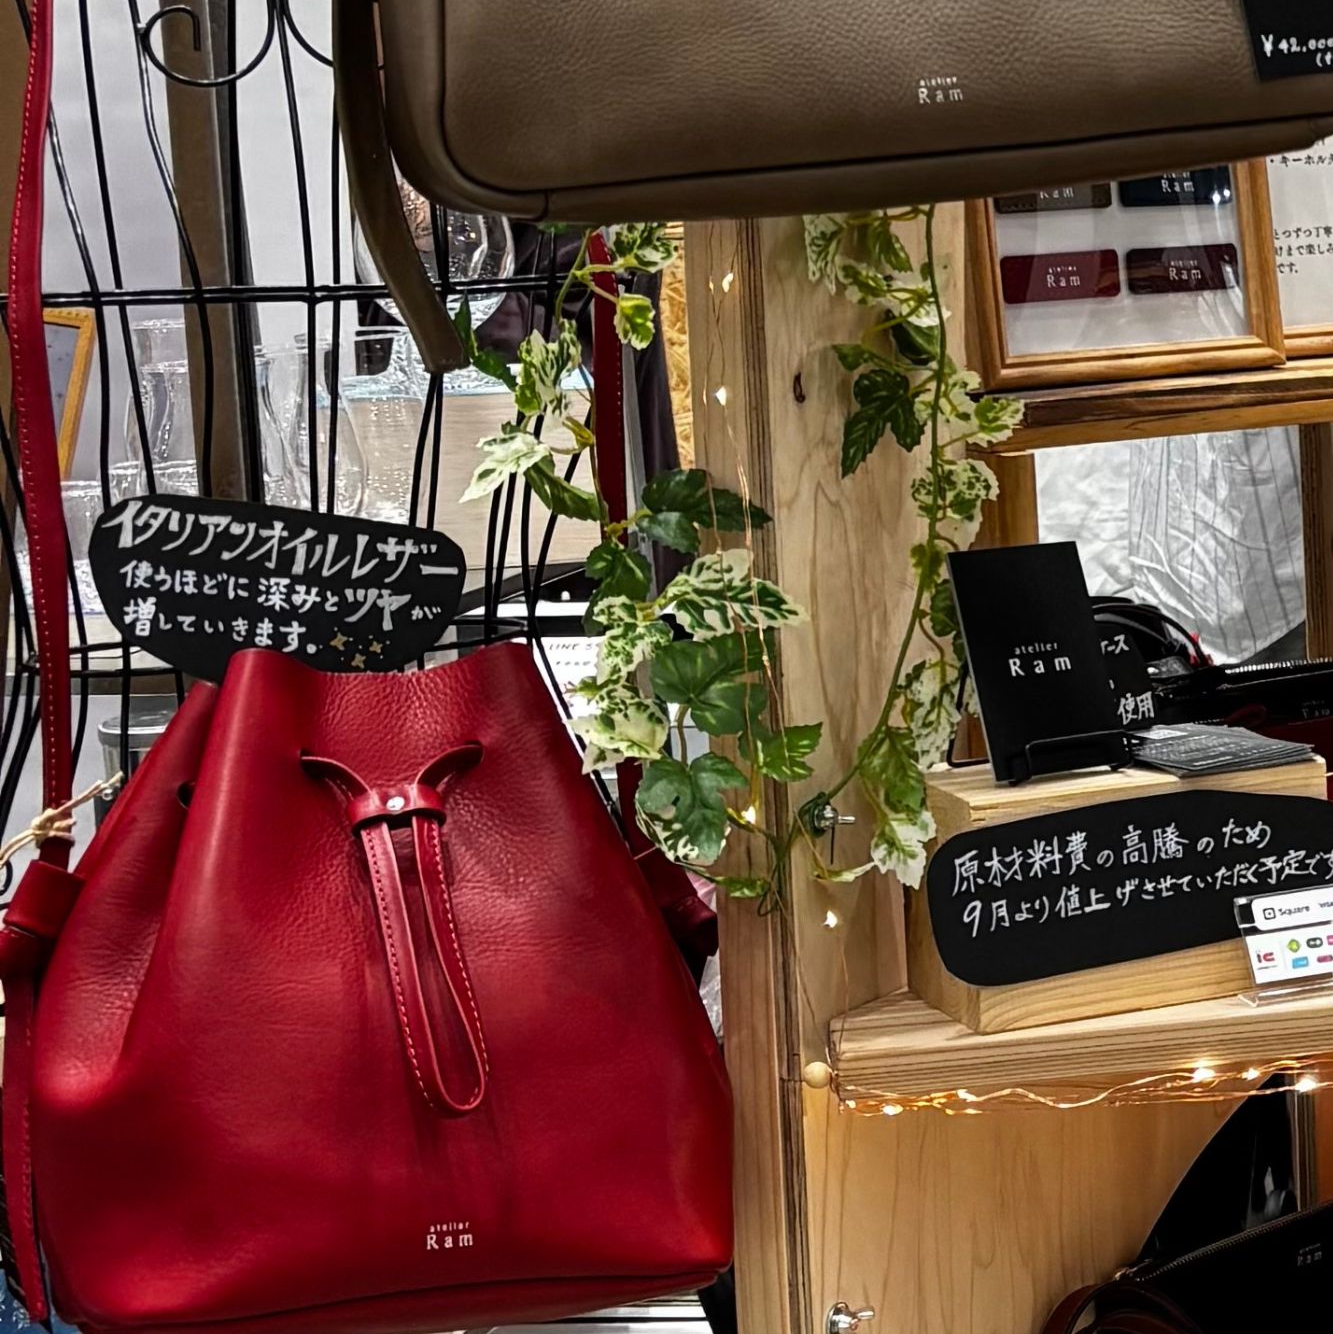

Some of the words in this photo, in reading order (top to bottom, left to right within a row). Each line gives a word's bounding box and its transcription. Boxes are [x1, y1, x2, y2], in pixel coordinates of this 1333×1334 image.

[918, 86, 964, 105] Ram
[1161, 179, 1195, 193] Ram
[1047, 274, 1081, 288] Ram
[1169, 267, 1201, 281] Ram
[101, 500, 459, 583] イタリアンオイルレザー
[120, 560, 442, 631] 使うほどに深みとツヤが
[123, 596, 317, 655] 増していきます。
[1014, 641, 1058, 655] atelier
[1009, 656, 1072, 677] Ram
[1117, 691, 1155, 725] 使用
[952, 818, 1271, 898] 原材料費の高騰のため
[427, 1234, 473, 1250] Ram
